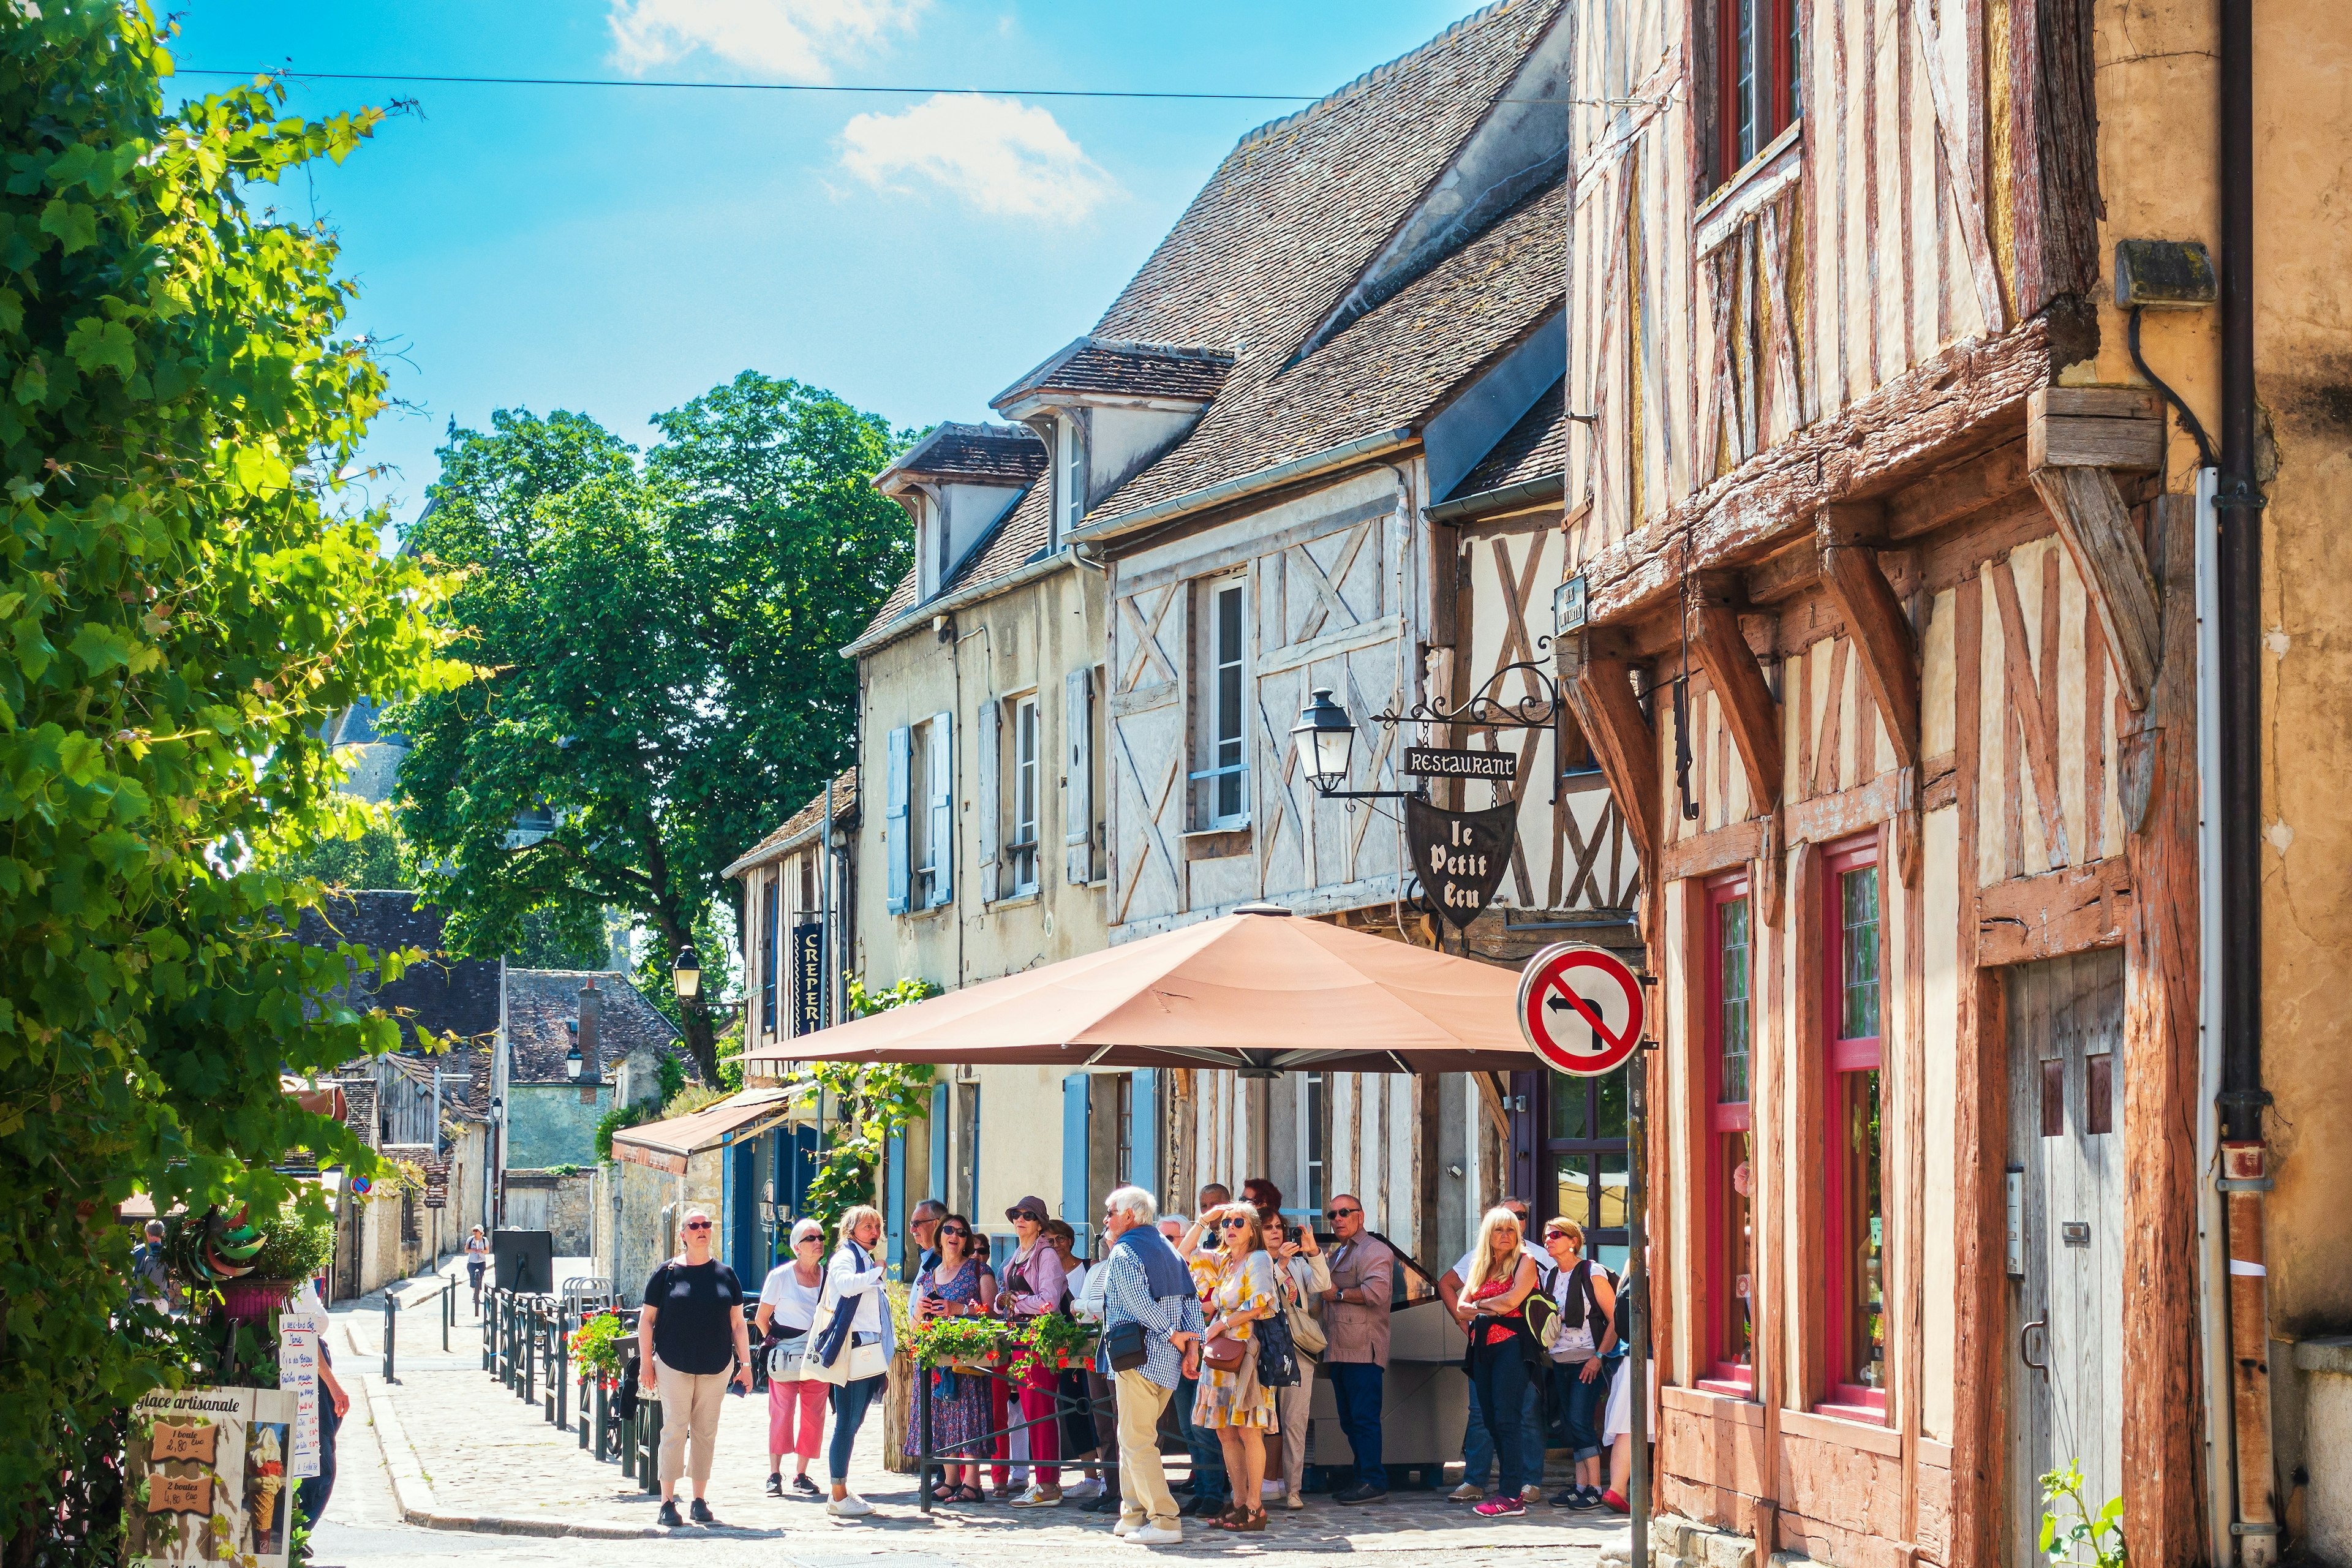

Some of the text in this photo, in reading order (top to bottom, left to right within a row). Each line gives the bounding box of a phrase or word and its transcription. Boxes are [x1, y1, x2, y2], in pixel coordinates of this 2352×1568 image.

[1564, 586, 1574, 603] RUE
[1430, 843, 1487, 877] Petit
[173, 1395, 240, 1413] artisanale
[172, 1430, 198, 1439] 1 boule
[167, 1482, 198, 1491] 2 boules
